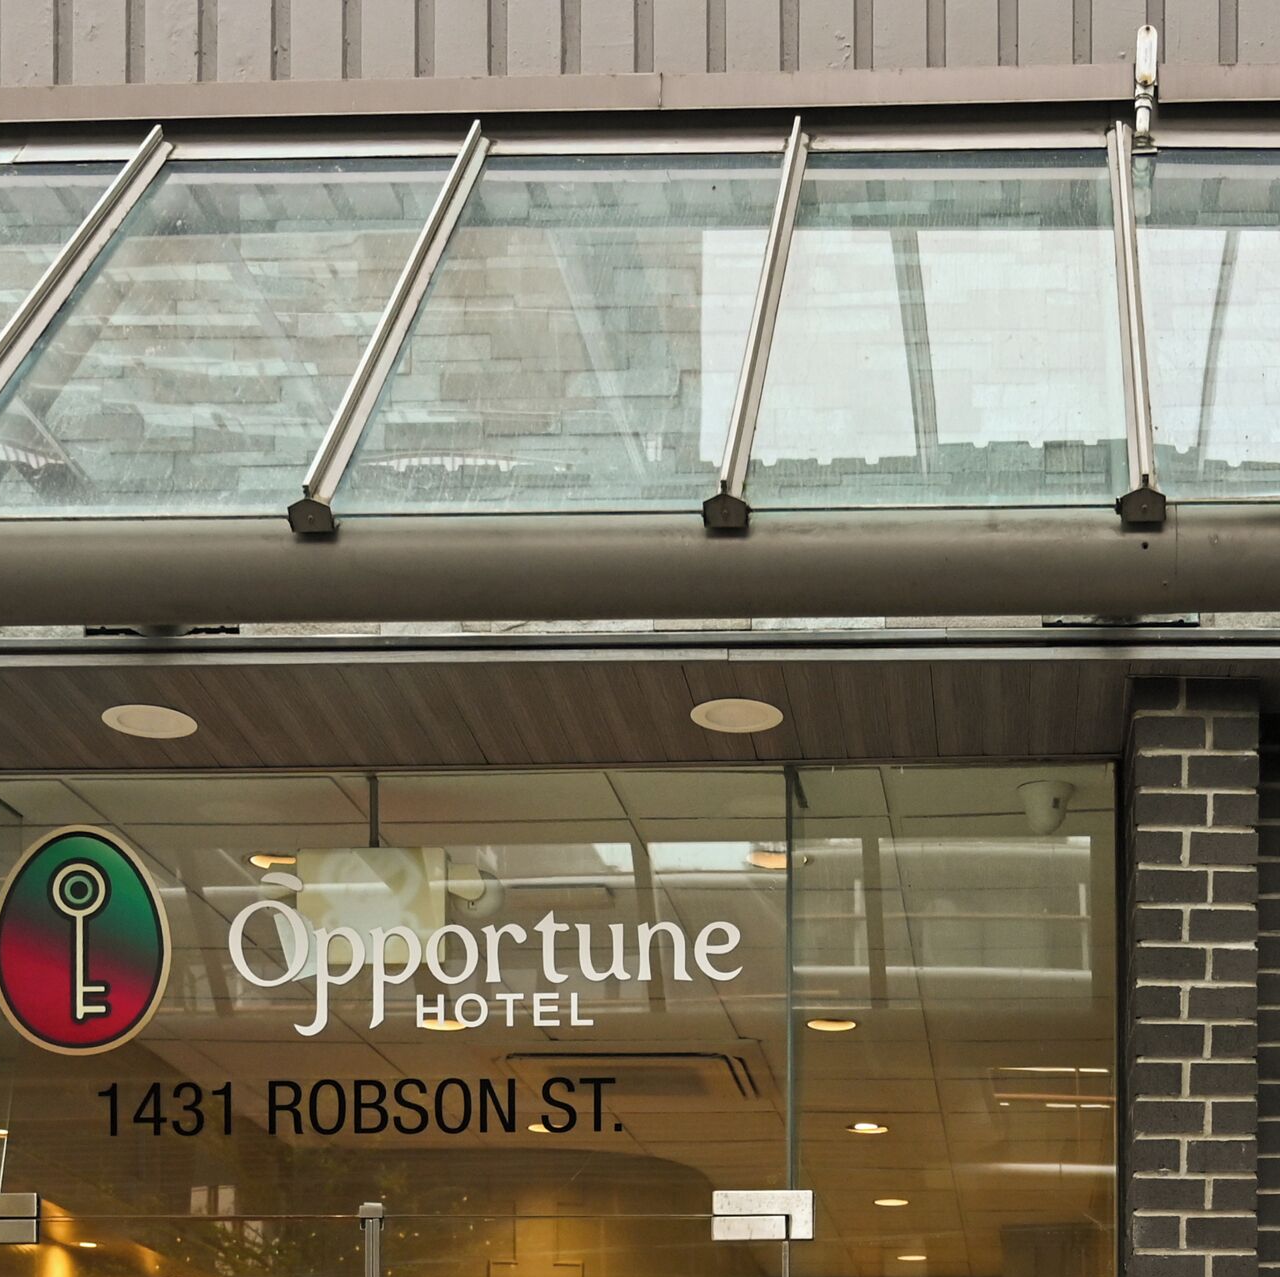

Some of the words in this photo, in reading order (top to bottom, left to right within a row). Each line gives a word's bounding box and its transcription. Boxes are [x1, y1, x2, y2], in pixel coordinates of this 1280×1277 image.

[416, 991, 594, 1028] HOTEL
[97, 1080, 235, 1137] 1431
[266, 1077, 517, 1136] ROBSON
[540, 1076, 623, 1134] ST.
